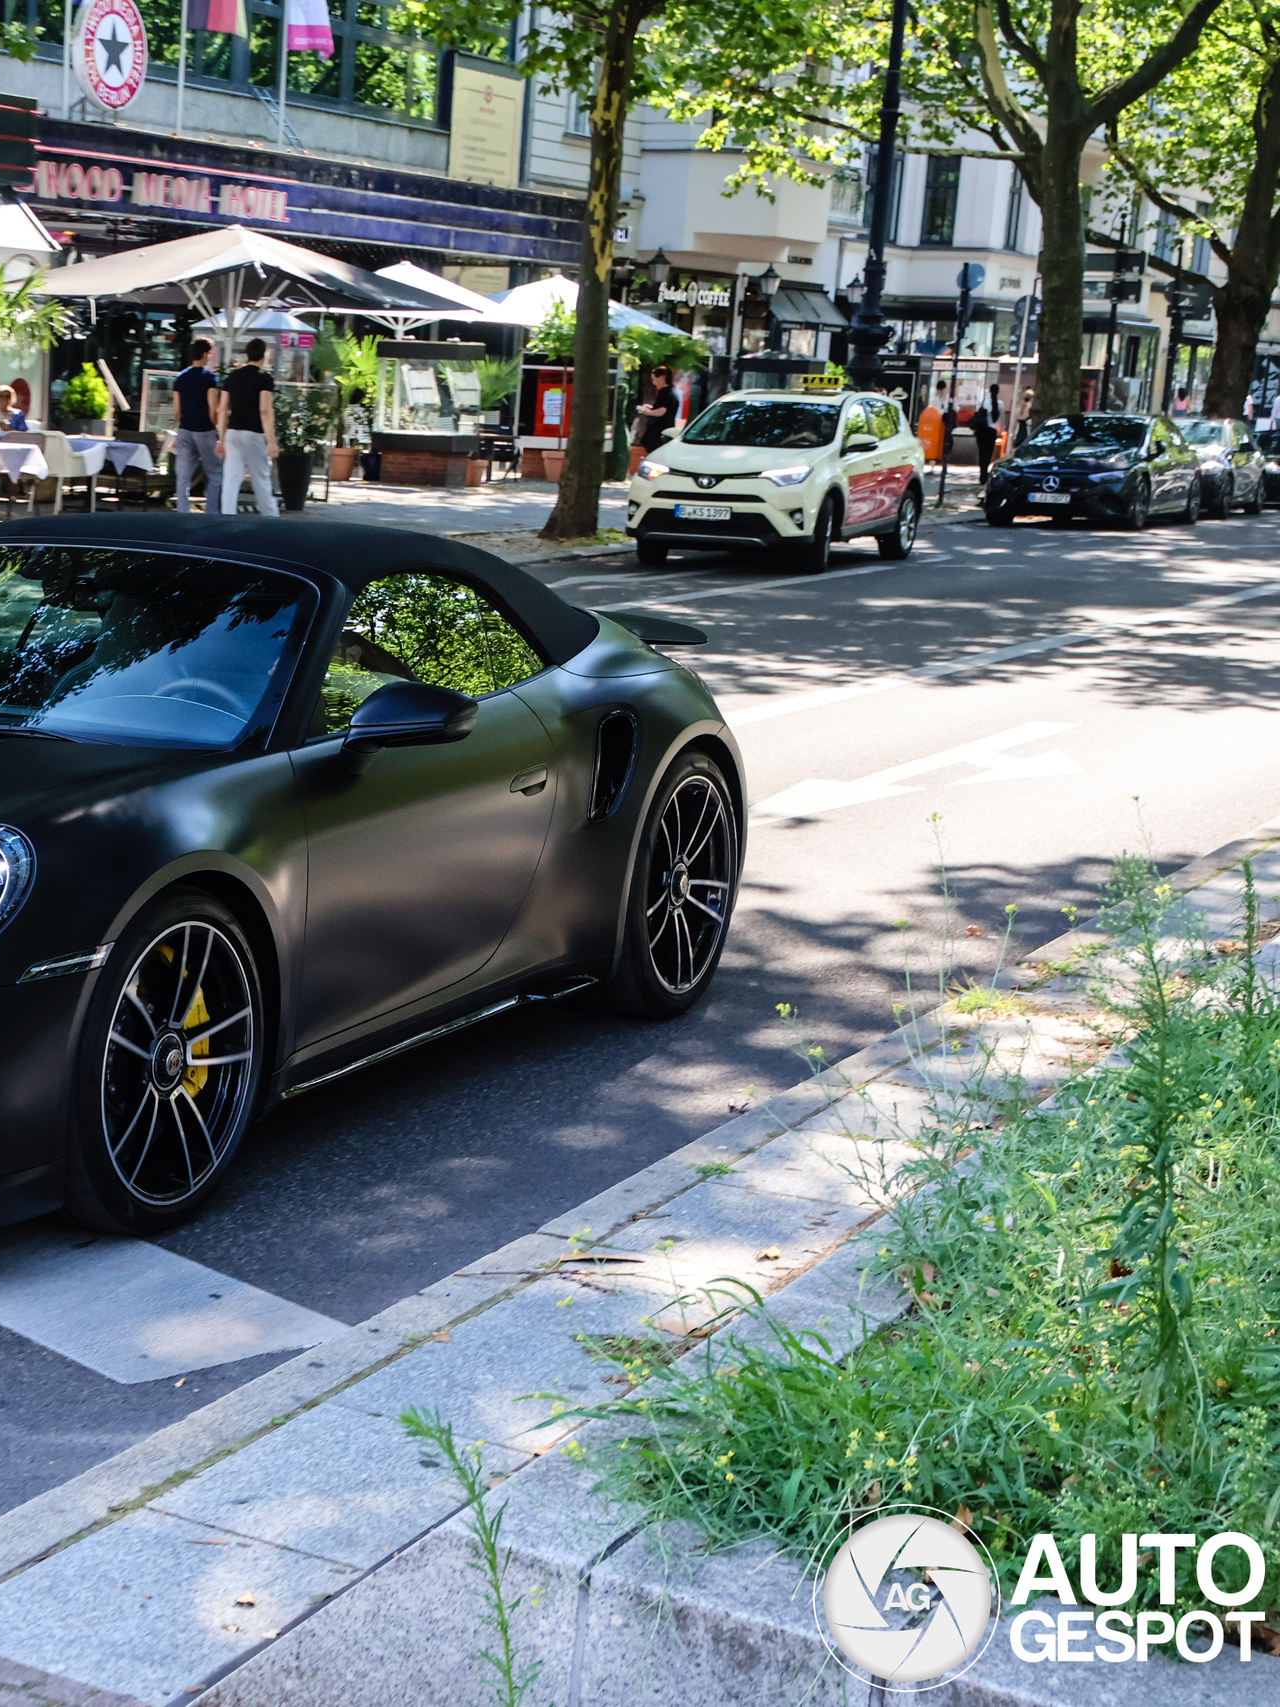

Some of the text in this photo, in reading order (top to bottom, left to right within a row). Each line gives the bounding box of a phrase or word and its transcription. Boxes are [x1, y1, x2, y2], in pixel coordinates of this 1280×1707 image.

[127, 40, 144, 89] HOTEL
[97, 81, 133, 106] BERLIN
[33, 160, 291, 223] WOOD MEDIA HOTEL
[698, 289, 730, 307] COFFEE
